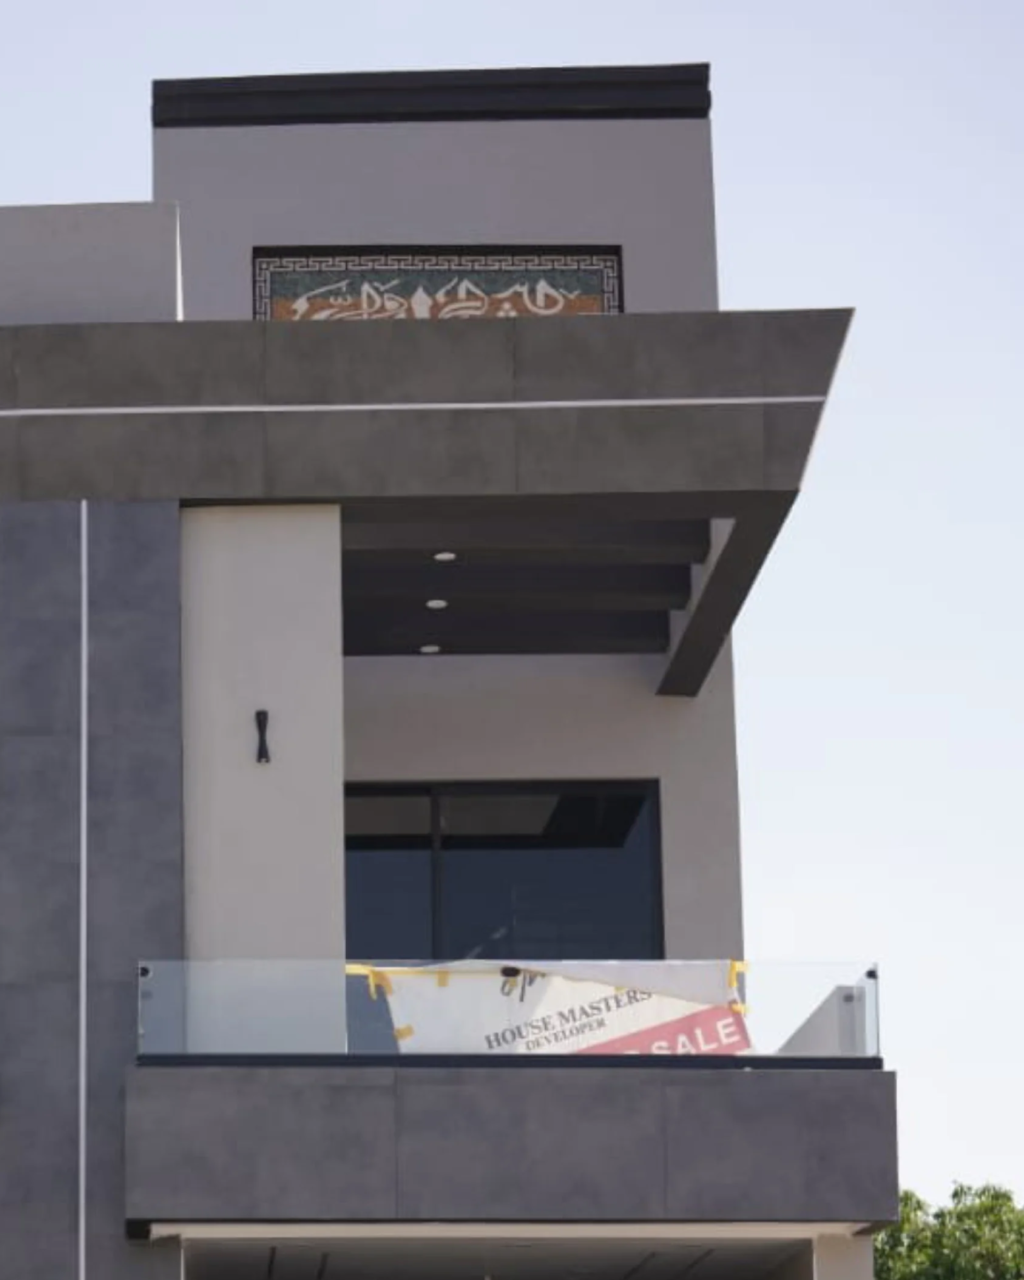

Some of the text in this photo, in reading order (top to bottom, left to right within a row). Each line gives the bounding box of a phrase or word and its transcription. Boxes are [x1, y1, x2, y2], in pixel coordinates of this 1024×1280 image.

[484, 990, 652, 1050] HOUSE MASTERS
[525, 1018, 607, 1051] DEVELOPER
[651, 1017, 741, 1055] SALE
